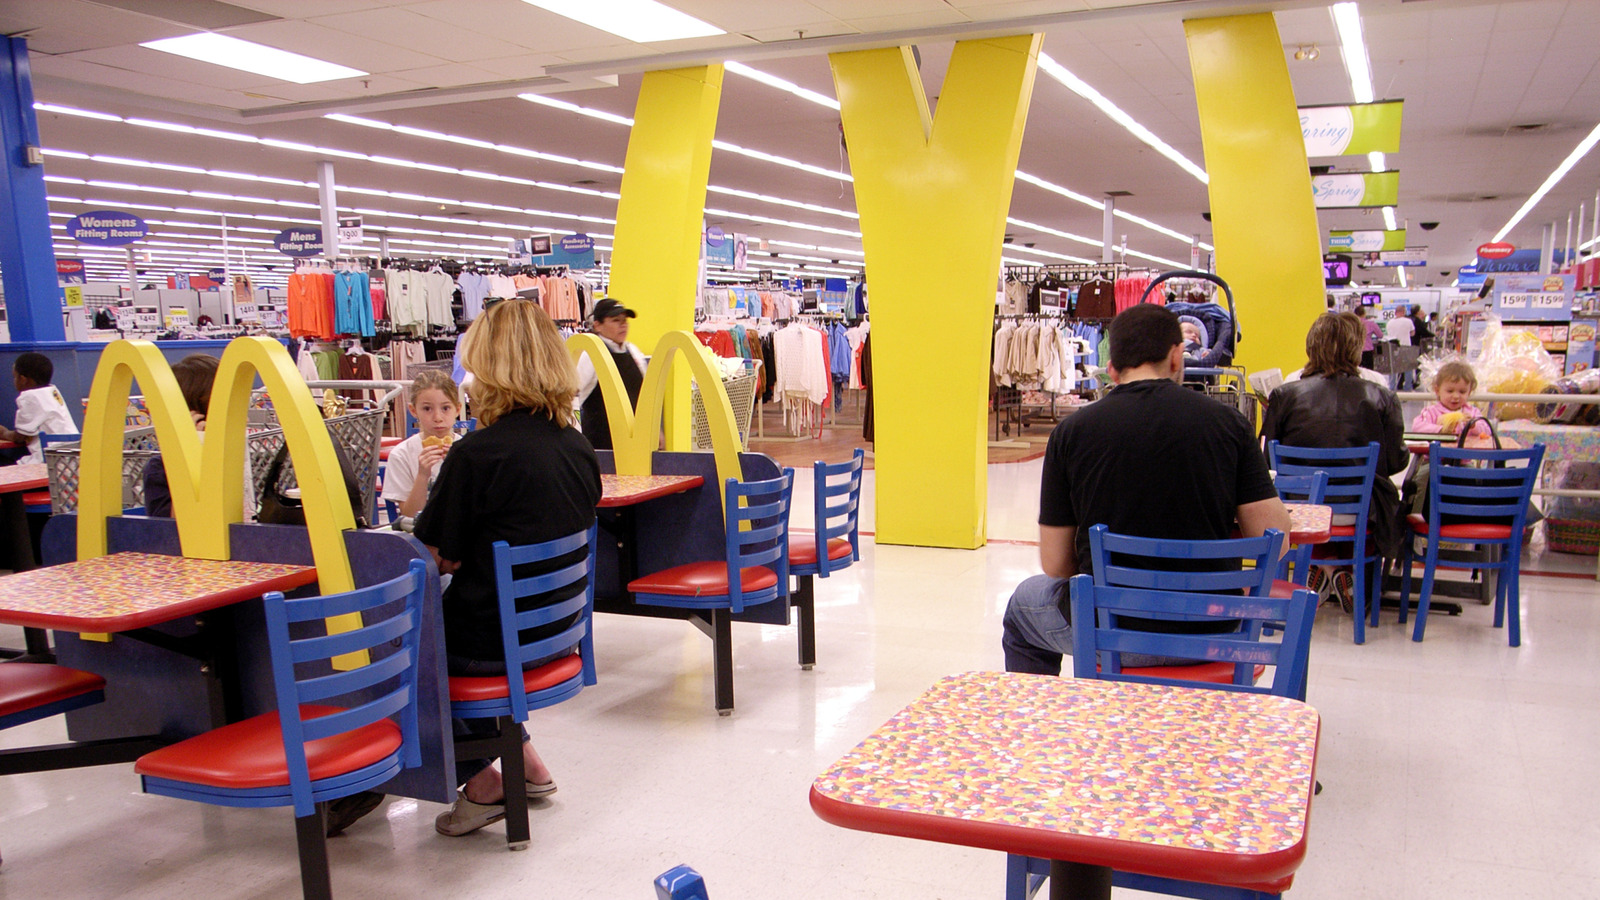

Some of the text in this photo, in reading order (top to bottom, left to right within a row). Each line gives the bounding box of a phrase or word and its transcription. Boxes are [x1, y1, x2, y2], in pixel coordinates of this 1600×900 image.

[1315, 180, 1360, 200] Spring
[80, 217, 137, 228] Womens
[75, 229, 143, 239] Fitting Rooms
[290, 232, 316, 242] Mens
[1355, 234, 1380, 247] Spring
[280, 242, 303, 252] Fitting
